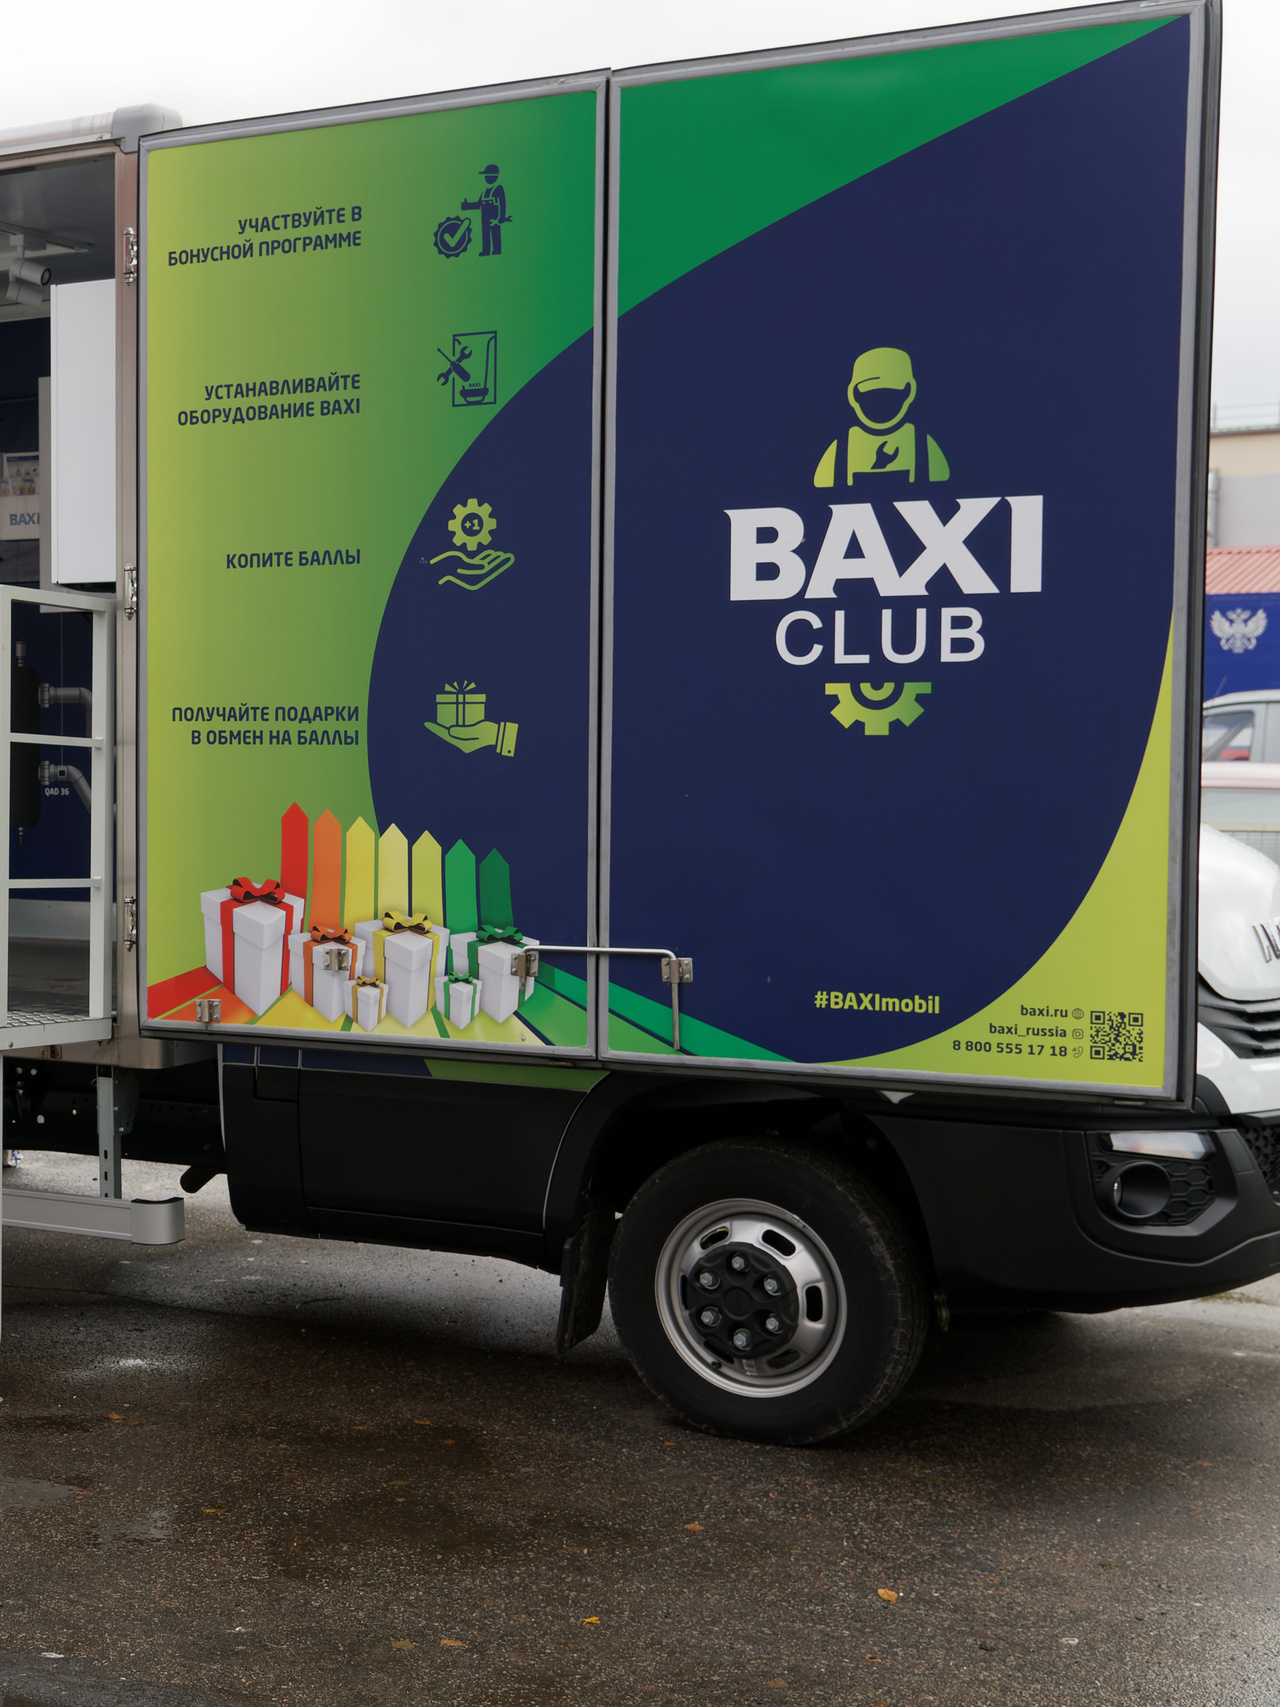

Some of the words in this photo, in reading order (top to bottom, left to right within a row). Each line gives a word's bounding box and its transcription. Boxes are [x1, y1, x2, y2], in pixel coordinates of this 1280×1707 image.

[238, 206, 346, 235] УЧАСТВУЙТЕ
[351, 206, 363, 221] В
[168, 238, 254, 267] БОНУСНОЙ
[258, 230, 362, 258] ПРОГРАММЕ
[204, 371, 361, 401] УСТАНАВЛИВАЙТЕ
[177, 401, 315, 427] ОБОРУДОВАНИЕ
[320, 398, 361, 417] BAXI
[226, 551, 293, 569] КОПИТЕ
[299, 549, 361, 567] БАЛЛЫ
[723, 495, 1044, 601] BAXI
[775, 606, 985, 665] CLUB
[172, 702, 270, 722] ПОЛУЧАЙТЕ
[275, 706, 359, 724] ПОДАРКИ
[191, 730, 201, 746] В
[206, 730, 264, 746] ОБМЕН
[269, 730, 292, 746] НА
[297, 730, 359, 746] БАЛЛЫ
[44, 787, 57, 796] QAD
[59, 787, 69, 796] 36
[814, 990, 940, 1014] #BAXImobil
[1020, 1005, 1068, 1019] baxi.ru
[989, 1023, 1067, 1039] baxi_russia
[952, 1040, 961, 1051] 8
[965, 1040, 992, 1053] 800
[996, 1042, 1023, 1055] 555
[1027, 1044, 1045, 1056] 17
[1050, 1045, 1068, 1057] 18
